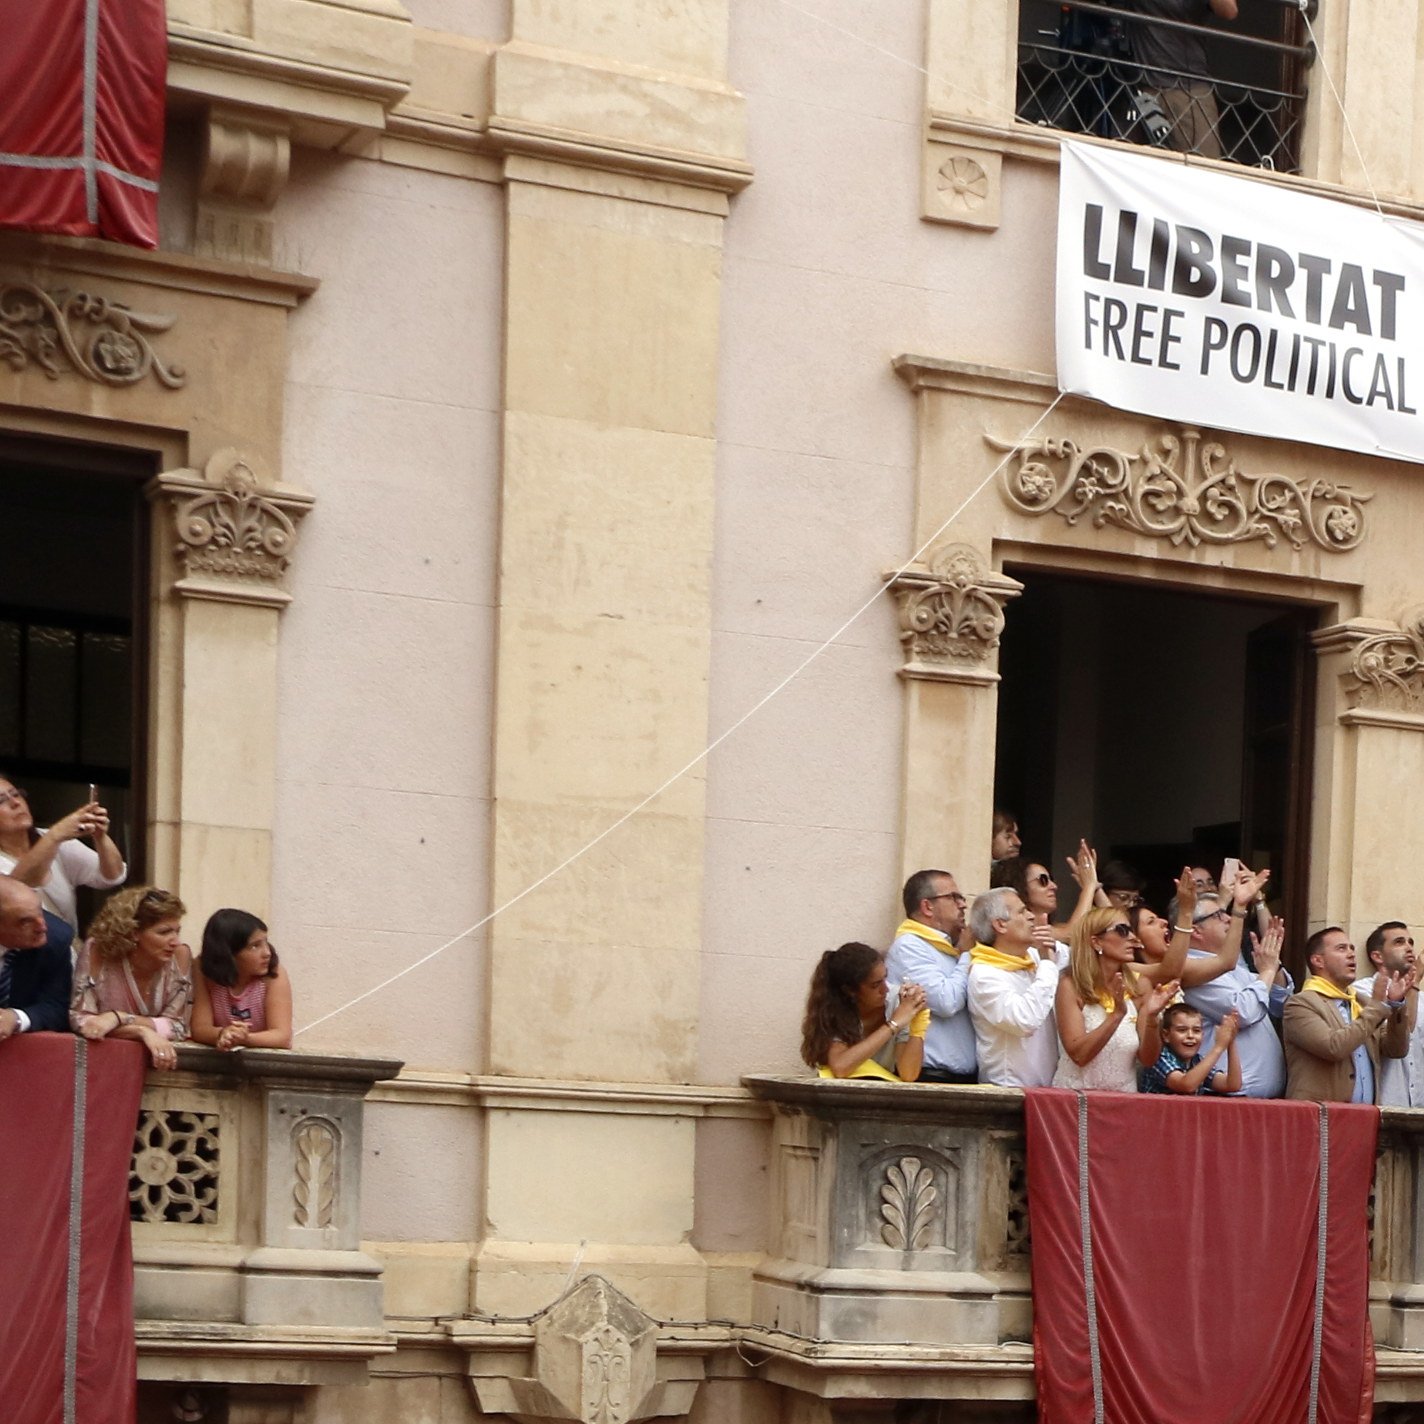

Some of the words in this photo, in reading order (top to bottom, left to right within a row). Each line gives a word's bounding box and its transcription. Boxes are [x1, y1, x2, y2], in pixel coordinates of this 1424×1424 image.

[1084, 202, 1406, 342] LLIBERTAT
[1084, 290, 1185, 371] FREE
[1200, 315, 1417, 415] POLITICAL
